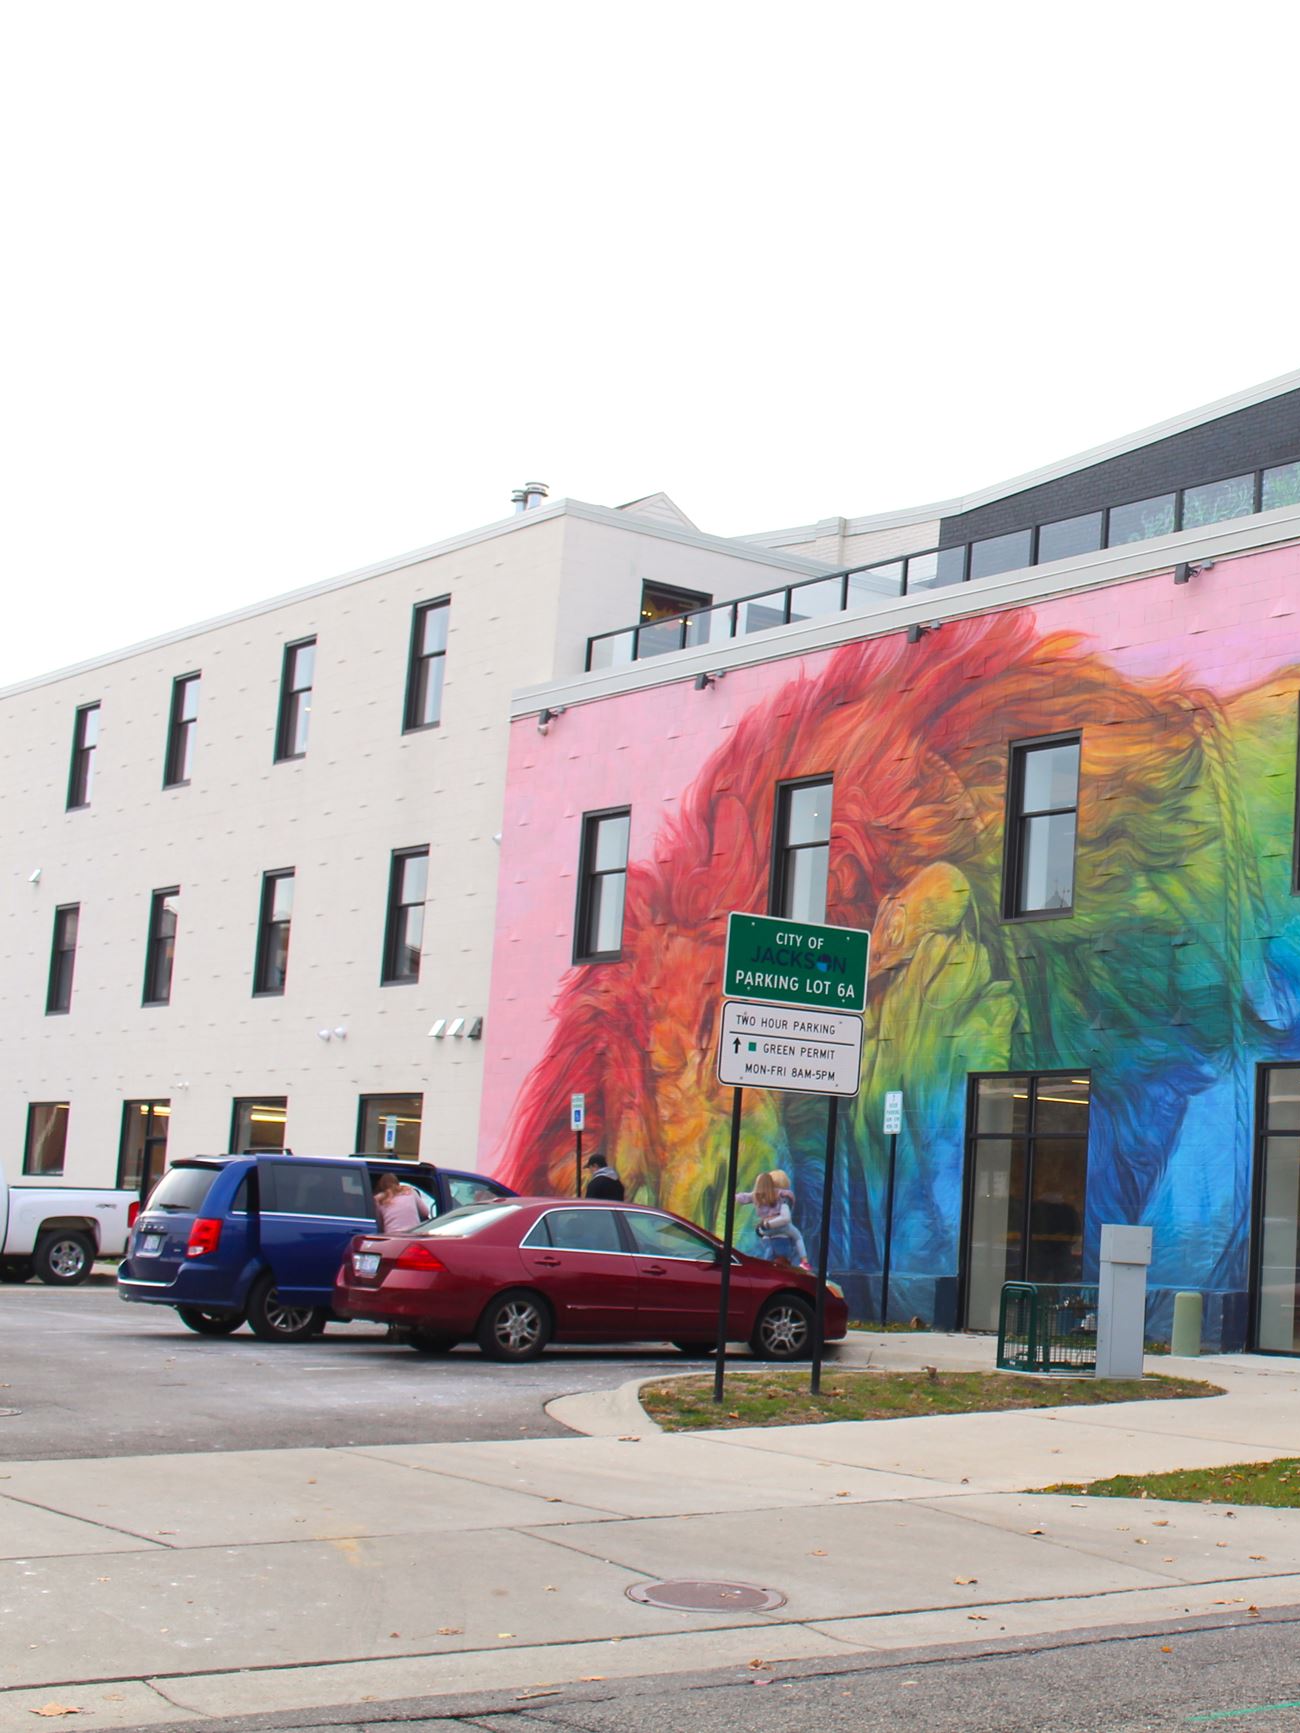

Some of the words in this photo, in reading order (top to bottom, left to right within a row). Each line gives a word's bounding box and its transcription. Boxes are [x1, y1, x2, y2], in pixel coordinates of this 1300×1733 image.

[776, 932, 803, 947] CITY
[808, 937, 824, 950] OF
[751, 946, 847, 975] JACKSON
[735, 970, 799, 991] PARKING
[806, 979, 831, 995] LOT
[837, 983, 855, 998] 6A
[736, 1014, 756, 1026] TWO
[761, 1018, 788, 1030] HOUR
[793, 1021, 836, 1035] PARKING
[763, 1043, 796, 1056] GREEN
[800, 1047, 835, 1060] PERMIT
[745, 1063, 787, 1076] MON-FRI
[791, 1068, 835, 1081] 8AM-5PM
